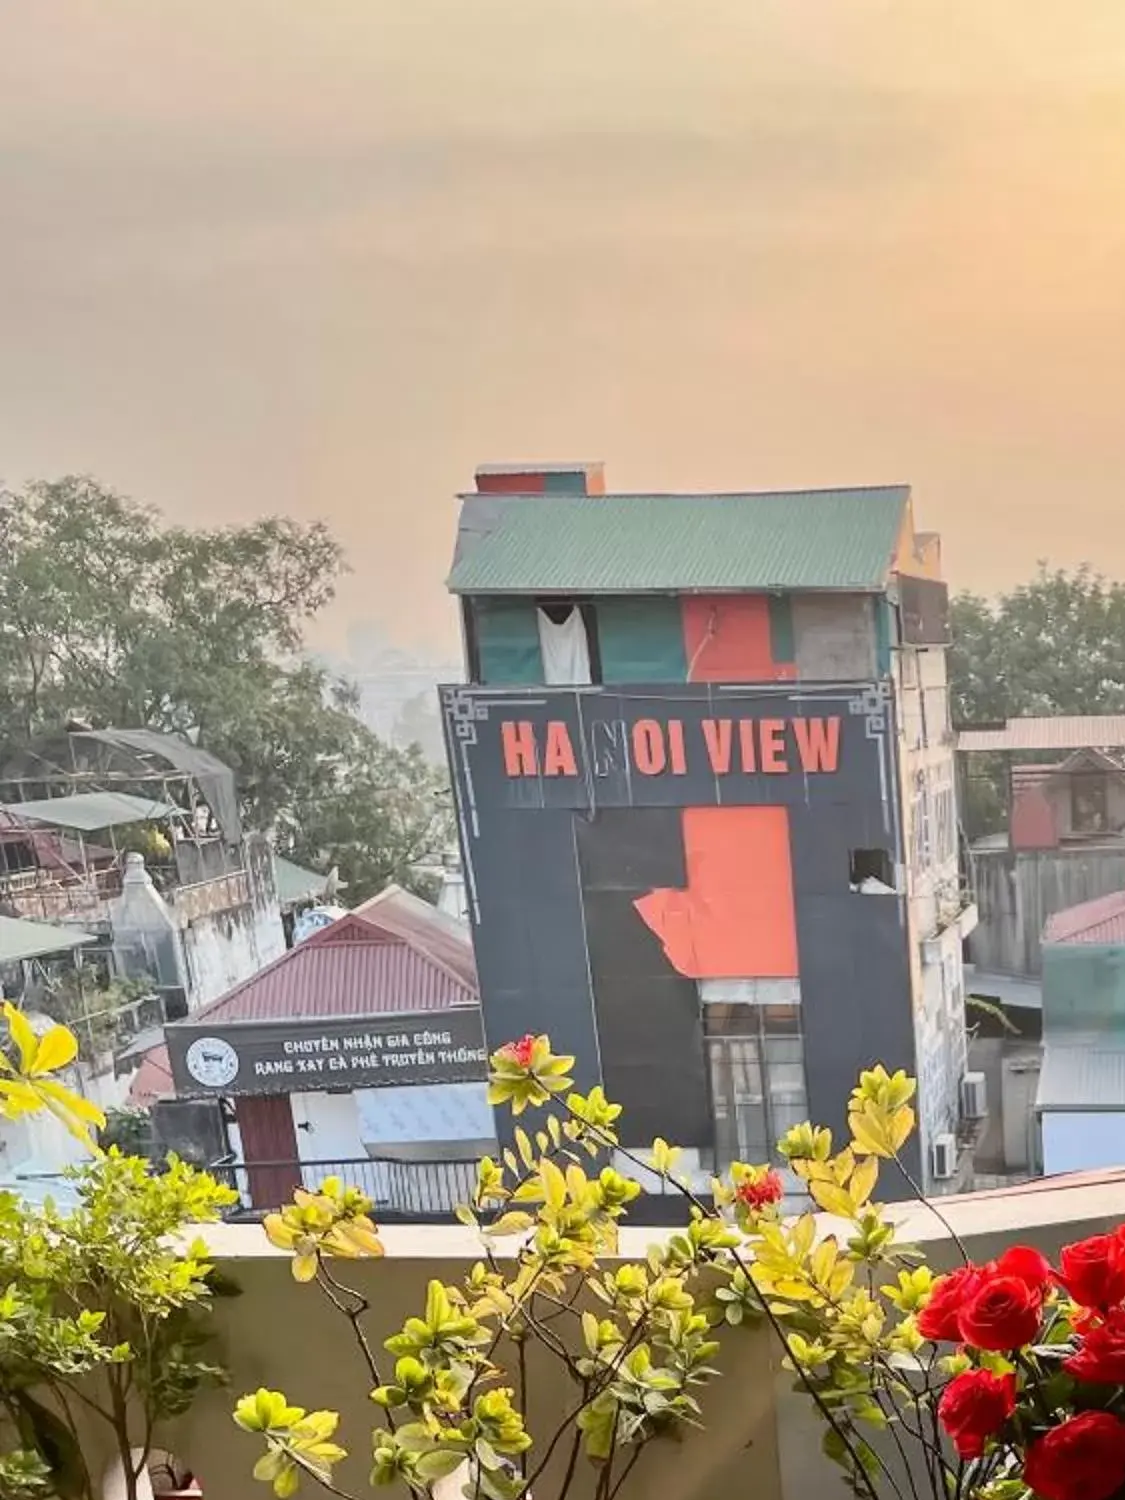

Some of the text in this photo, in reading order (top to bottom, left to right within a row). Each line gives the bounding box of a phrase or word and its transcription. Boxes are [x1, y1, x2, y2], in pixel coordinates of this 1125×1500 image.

[700, 716, 842, 775] VIEW
[283, 1030, 452, 1054] CHUYÊN NHẬN GIA CÔNG
[255, 1060, 294, 1076] RANG
[297, 1059, 325, 1073] XAY
[329, 1054, 348, 1071] CÀ
[351, 1051, 380, 1069] PHÊ
